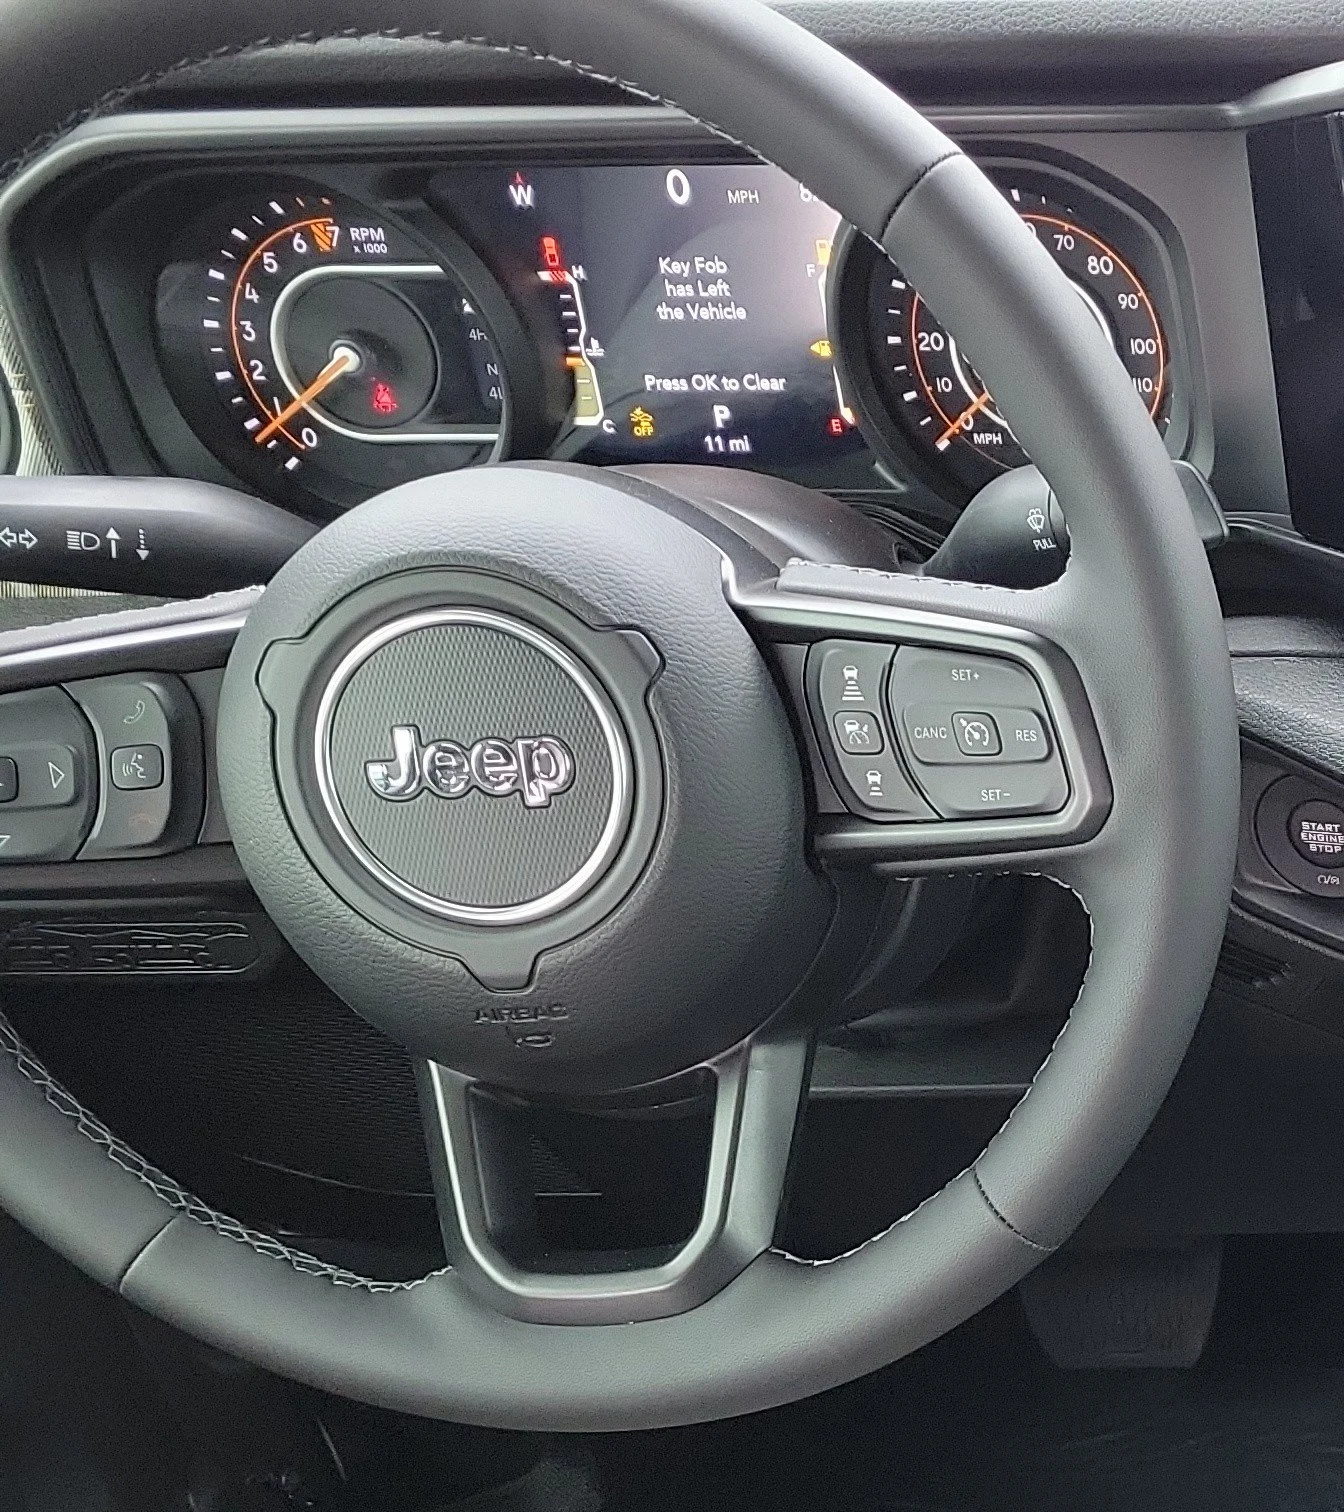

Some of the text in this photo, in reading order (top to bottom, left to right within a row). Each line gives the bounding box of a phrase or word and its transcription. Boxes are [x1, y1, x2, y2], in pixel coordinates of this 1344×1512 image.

[509, 184, 535, 207] W
[666, 168, 760, 206] 0 MPH
[293, 233, 307, 253] 6
[326, 225, 340, 247] 7
[349, 227, 385, 242] RPM
[1053, 234, 1075, 251] 70
[363, 243, 388, 254] 1000
[263, 252, 278, 273] 5
[658, 255, 728, 278] Key Fob
[1087, 255, 1114, 275] 80
[244, 283, 260, 303] 4
[665, 279, 731, 298] has Left
[1117, 293, 1139, 310] 90
[656, 302, 747, 321] the Vehicle
[239, 320, 256, 341] 3
[917, 331, 945, 351] 20
[1130, 338, 1157, 355] 100
[250, 359, 267, 381] 2
[644, 373, 787, 392] Press OK to Clear
[935, 376, 952, 393] 10
[713, 404, 732, 428] P
[831, 418, 843, 433] E
[301, 427, 318, 447] 0
[704, 434, 750, 453] 11 mi
[973, 433, 1003, 445] MPH
[1032, 537, 1057, 551] PULL
[913, 726, 948, 741] CANC
[1015, 729, 1038, 742] RES
[366, 724, 577, 809] Jeep
[1301, 821, 1341, 832] START
[1309, 843, 1343, 854] STOP
